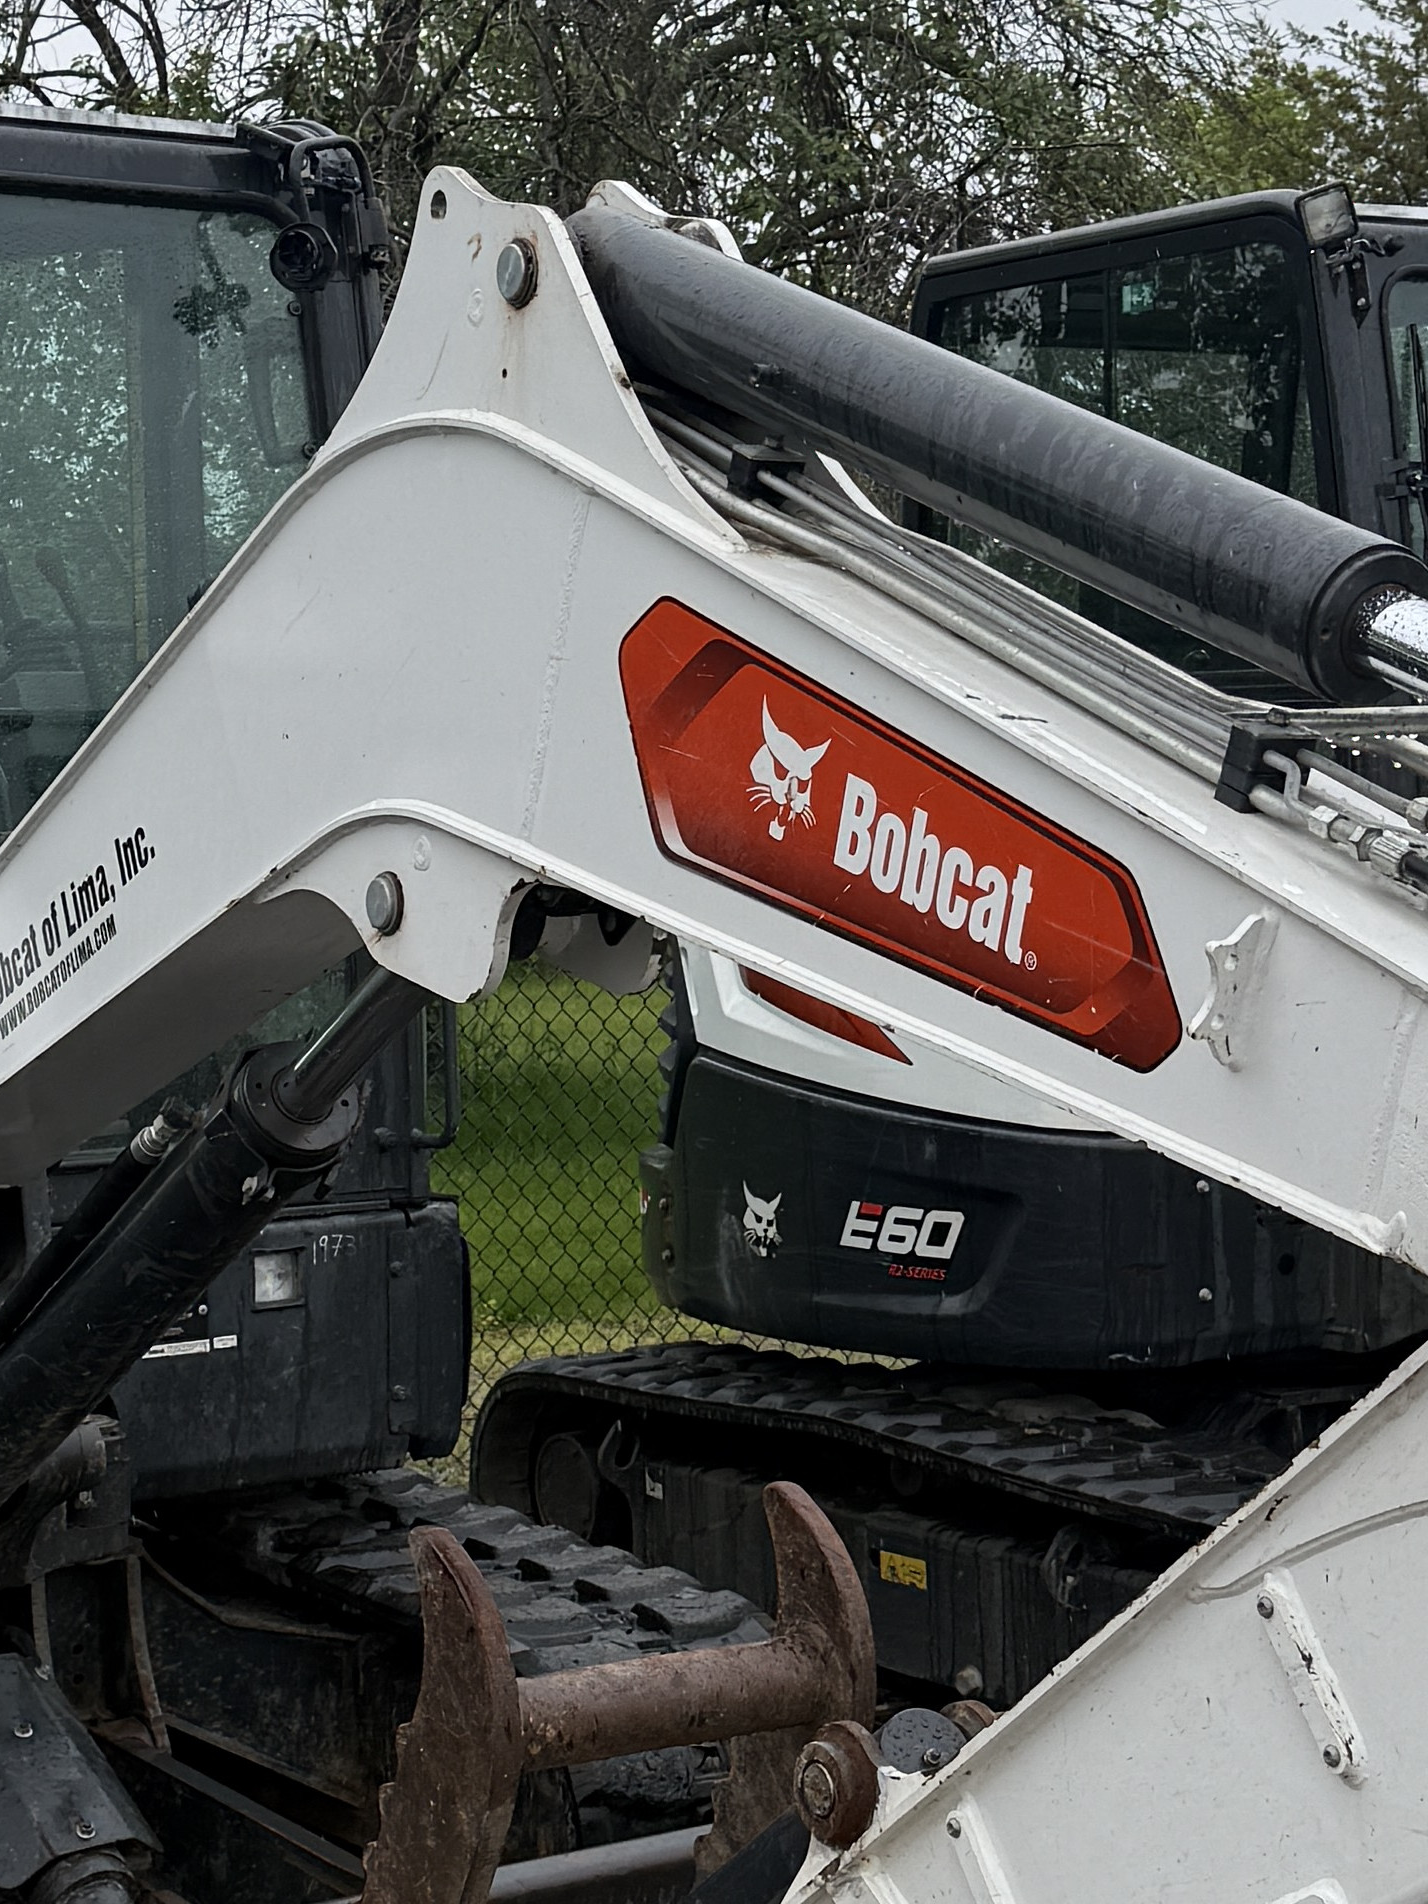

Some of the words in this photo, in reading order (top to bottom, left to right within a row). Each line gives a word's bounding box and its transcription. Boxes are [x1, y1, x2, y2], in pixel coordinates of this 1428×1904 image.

[41, 900, 61, 957] of
[60, 864, 116, 938] Lima,
[114, 826, 155, 886] Inc.
[833, 773, 1034, 964] Bobcat
[839, 1200, 965, 1260] E60
[888, 1264, 947, 1281] R2-SERIES
